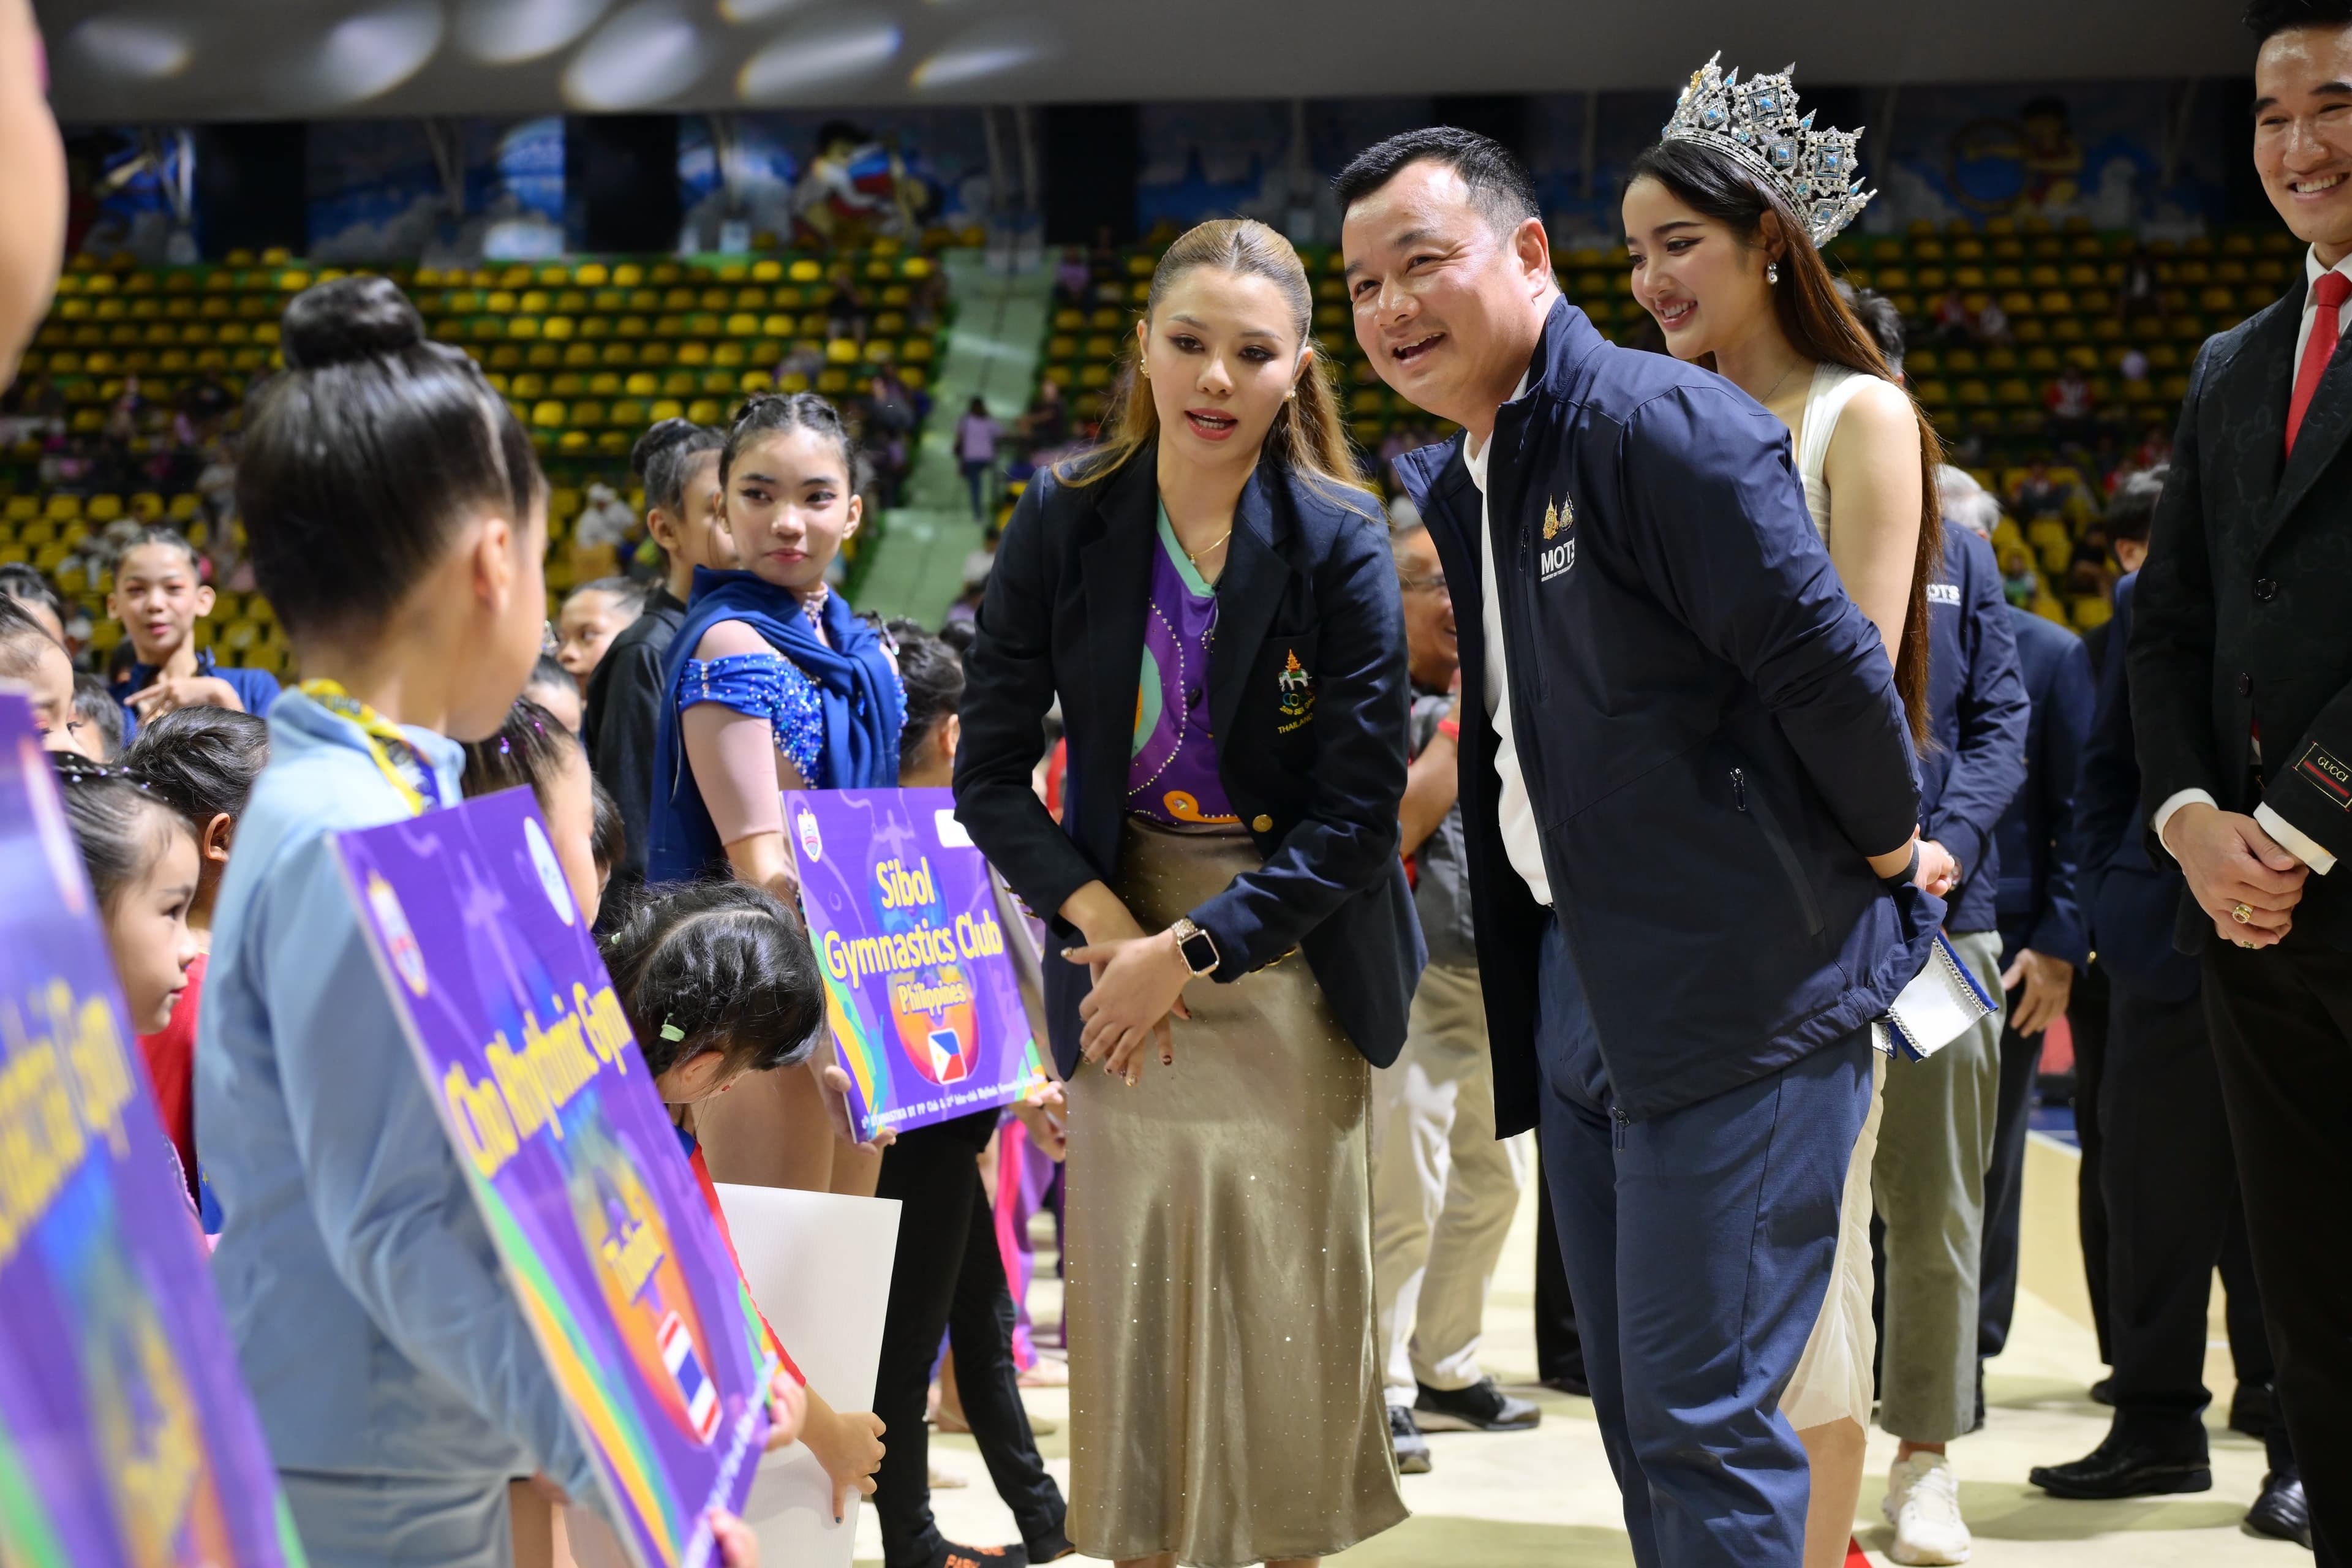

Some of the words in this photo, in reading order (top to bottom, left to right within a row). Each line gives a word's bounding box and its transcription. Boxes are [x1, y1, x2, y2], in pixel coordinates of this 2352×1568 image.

[1277, 712, 1313, 734] THAILAND
[2318, 756, 2349, 783] GUCCI
[876, 856, 936, 909] Sibol
[824, 918, 957, 990] Gymnastics
[956, 909, 1004, 960] Club
[897, 980, 967, 1017] Philippines
